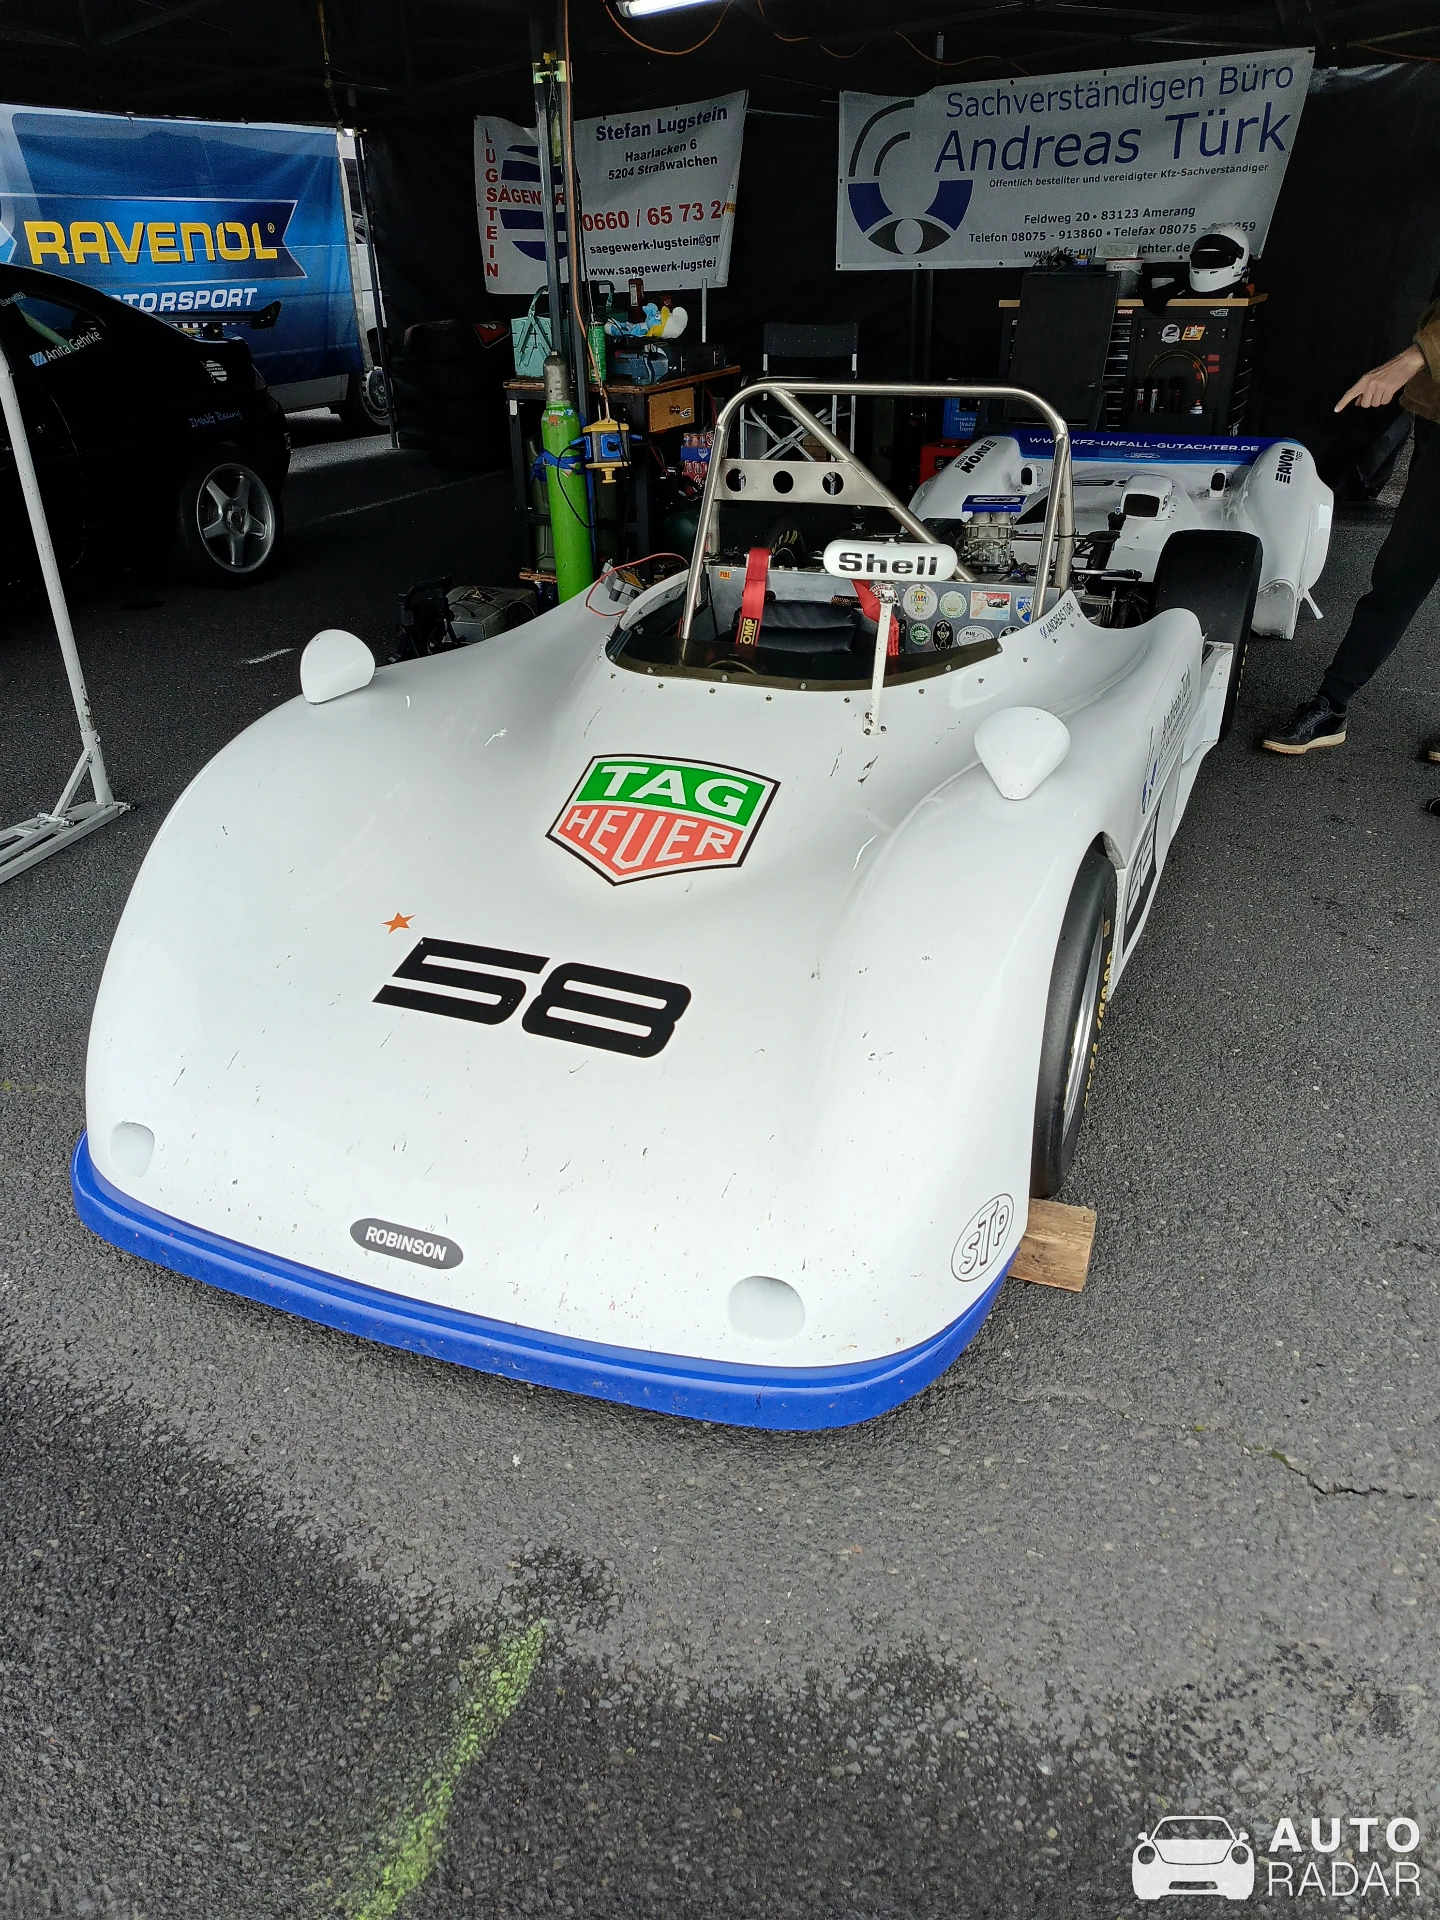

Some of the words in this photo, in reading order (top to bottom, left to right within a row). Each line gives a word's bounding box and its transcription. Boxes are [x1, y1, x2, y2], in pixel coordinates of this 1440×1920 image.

[946, 73, 1205, 118] Sachverständigen
[1218, 64, 1295, 96] Büro
[596, 122, 651, 141] Stefan
[657, 106, 727, 135] Lugstein
[934, 124, 1141, 174] Andreas
[1165, 102, 1292, 160] Türk
[625, 144, 687, 162] Haarlacken
[690, 138, 698, 150] 6
[608, 166, 634, 181] 5204
[637, 155, 718, 175] Straßwalchen
[989, 175, 1032, 188] Öffentlich
[1035, 172, 1079, 187] bestellter
[1082, 172, 1101, 184] und
[1103, 170, 1157, 184] vereidigter
[1160, 163, 1269, 179] Kfz-Sachverständiger
[485, 128, 499, 278] LUGSTEIN
[582, 210, 630, 231] 0660
[647, 205, 673, 226] 65
[679, 202, 705, 222] 73
[1024, 211, 1071, 225] Feldweg
[1075, 212, 1090, 222] 20
[1101, 208, 1139, 220] 83123
[1142, 206, 1195, 219] Amerang
[969, 232, 1007, 243] Telefon
[1011, 231, 1046, 242] 08075
[1058, 228, 1102, 240] 913860
[1114, 226, 1156, 237] Telefax
[1159, 224, 1197, 235] 08075
[45, 344, 71, 362] Anita
[69, 331, 103, 350] Gehrke
[960, 444, 992, 473] AVON
[1277, 447, 1296, 475] AVON
[838, 551, 938, 576] Shell
[742, 618, 756, 645] OMP
[600, 765, 750, 817] TAG
[565, 808, 735, 868] HEUER
[371, 936, 692, 1059] 58
[365, 1225, 447, 1262] ROBINSON
[959, 1200, 1010, 1275] STP
